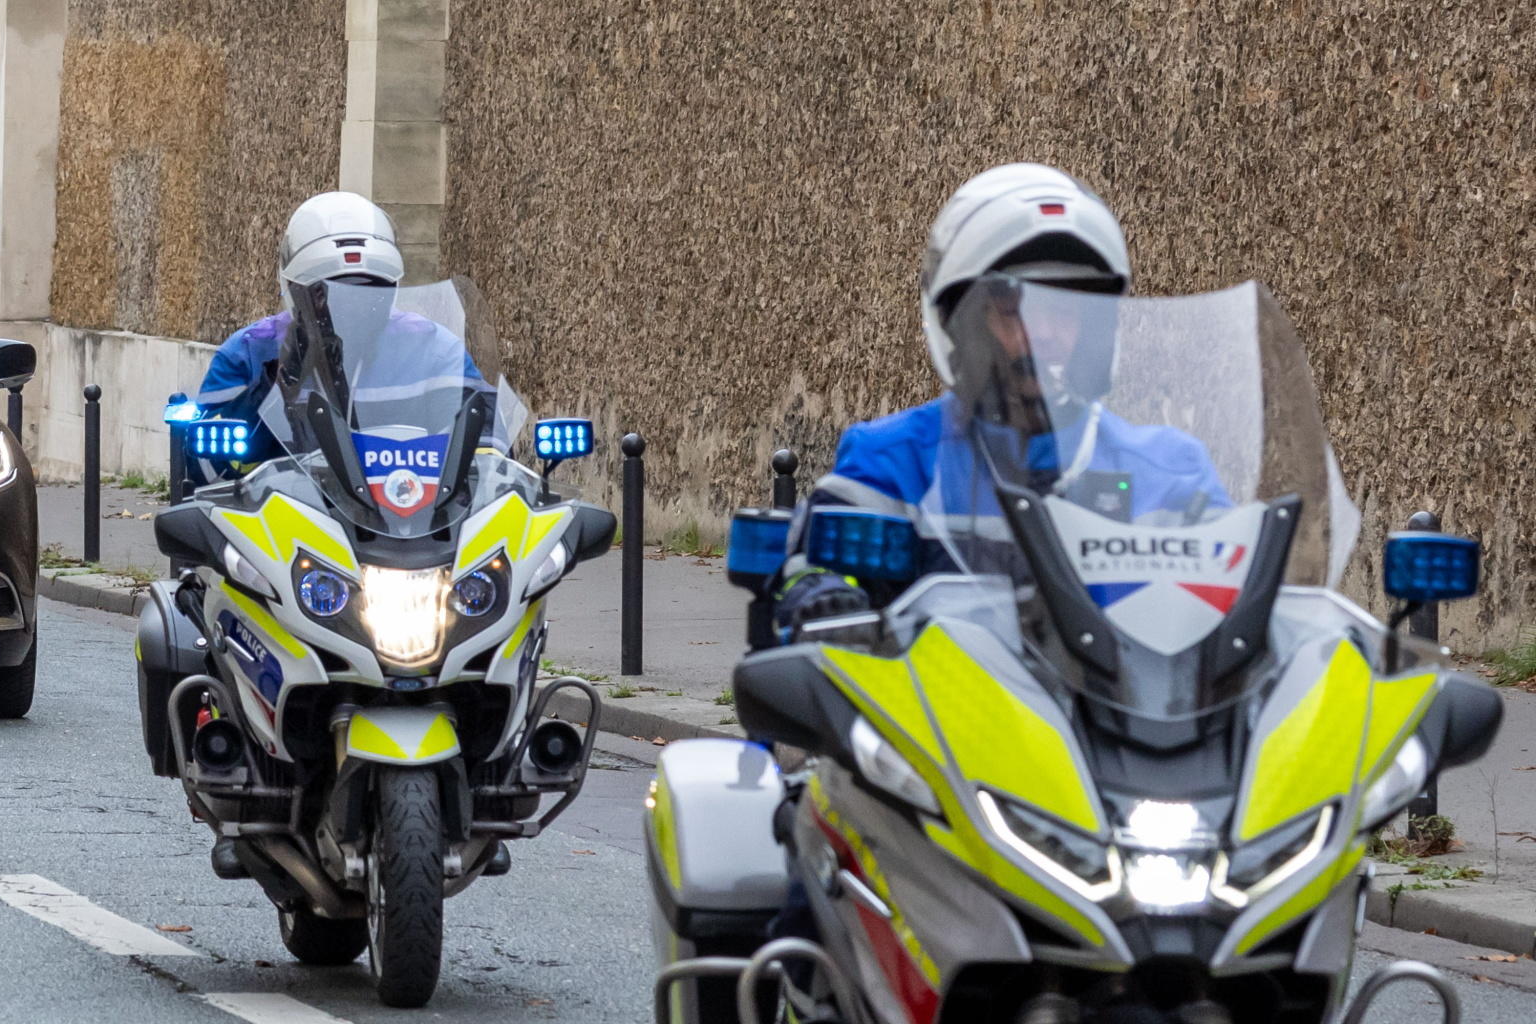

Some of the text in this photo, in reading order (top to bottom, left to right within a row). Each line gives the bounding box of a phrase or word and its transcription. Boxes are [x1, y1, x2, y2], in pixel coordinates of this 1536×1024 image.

[364, 449, 440, 468] POLICE
[1080, 537, 1201, 558] POLICE
[1081, 560, 1201, 572] NATIONALE
[235, 622, 267, 663] POLICE
